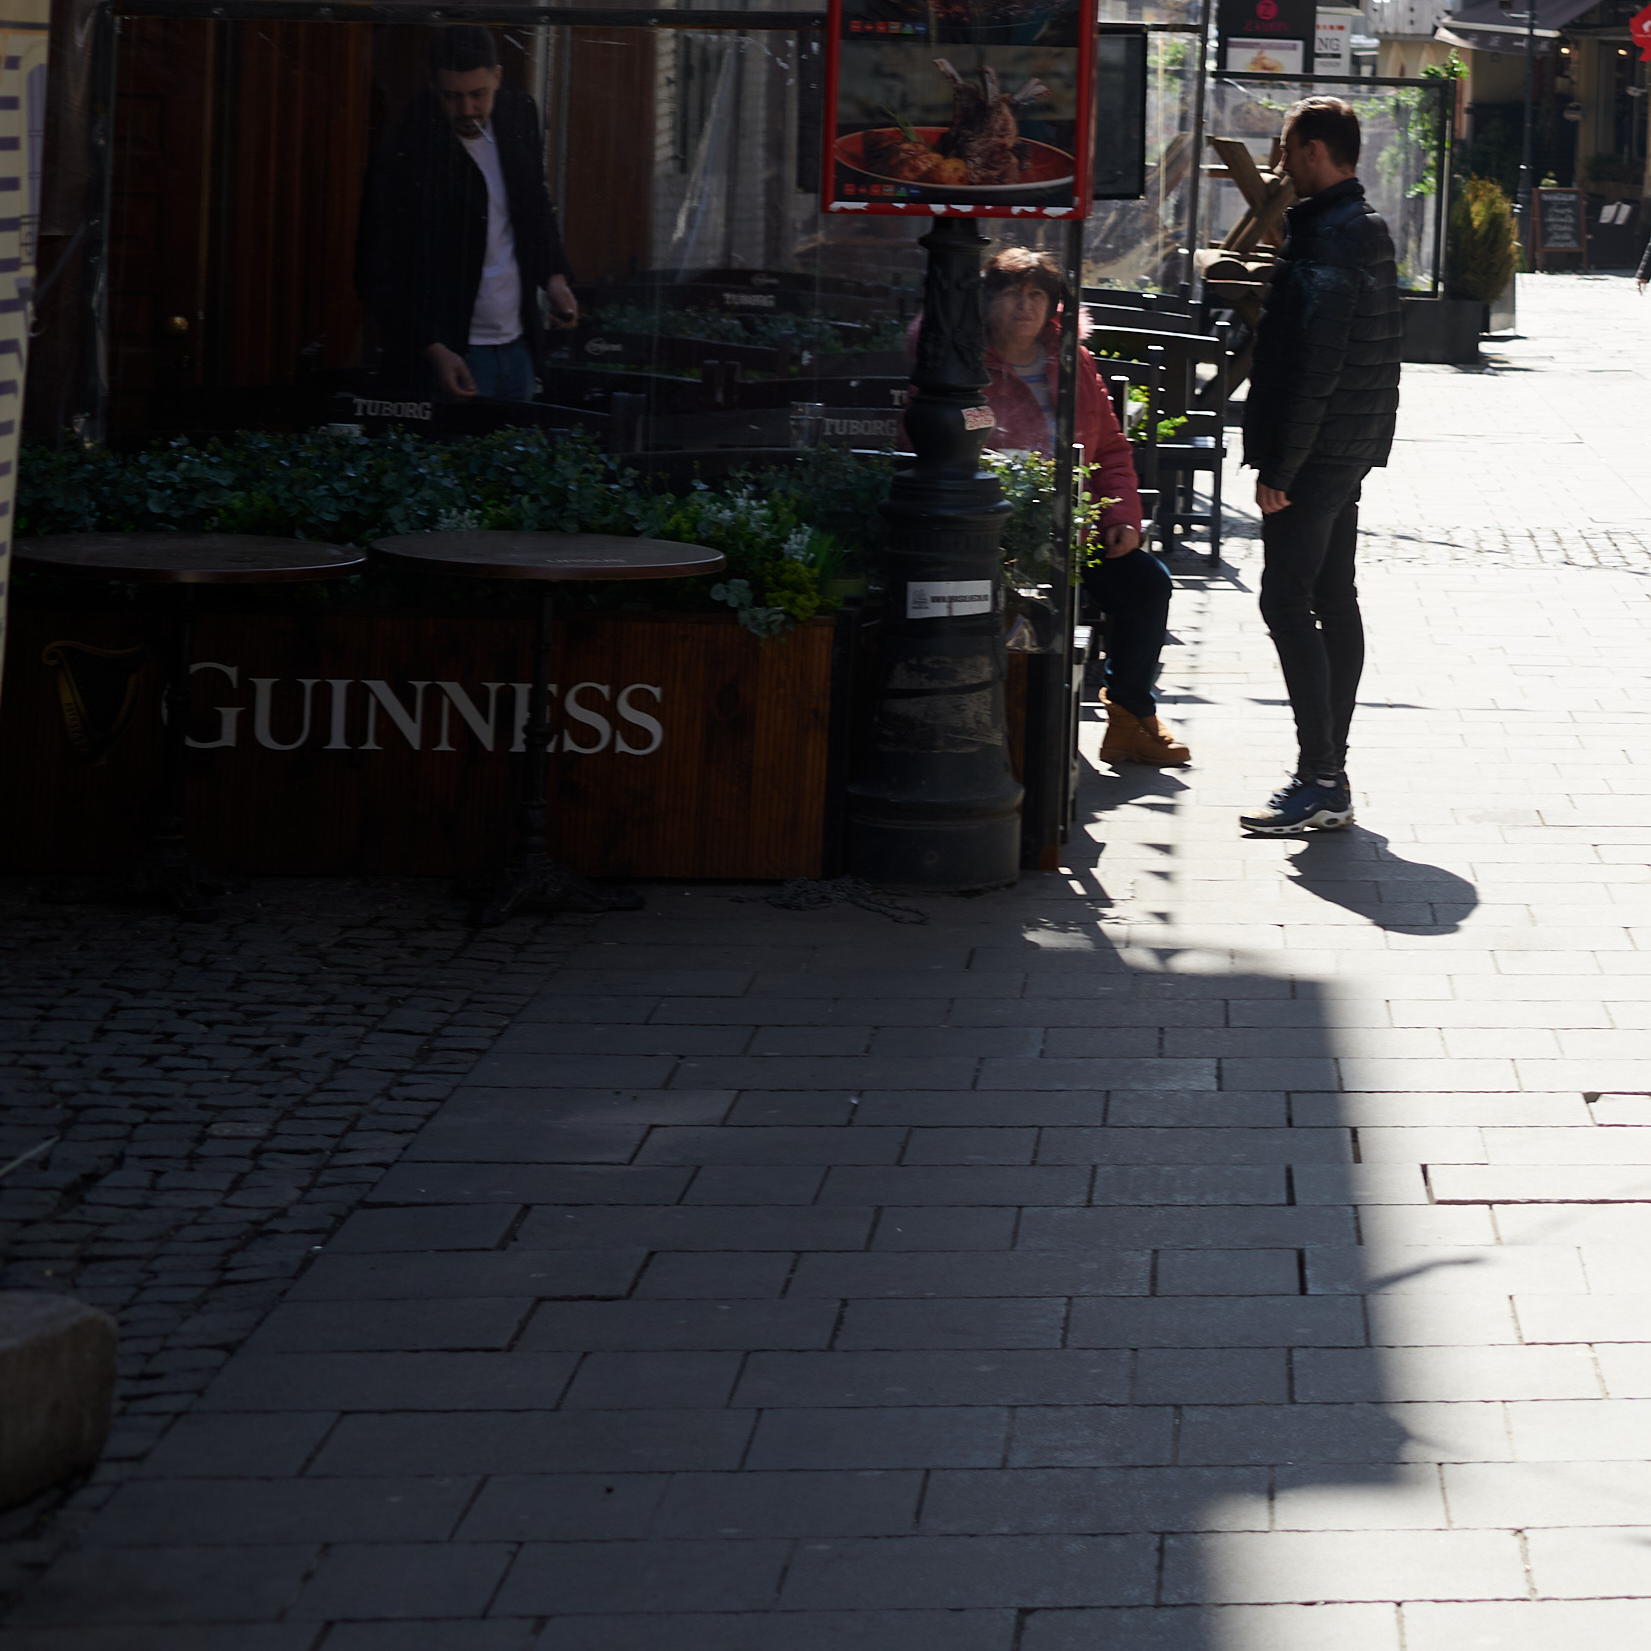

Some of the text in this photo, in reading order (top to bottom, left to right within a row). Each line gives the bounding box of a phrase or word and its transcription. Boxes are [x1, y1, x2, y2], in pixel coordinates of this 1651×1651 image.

[353, 398, 432, 421] TUBORG
[822, 417, 898, 437] TUBORG
[162, 661, 664, 757] GUINNESS
